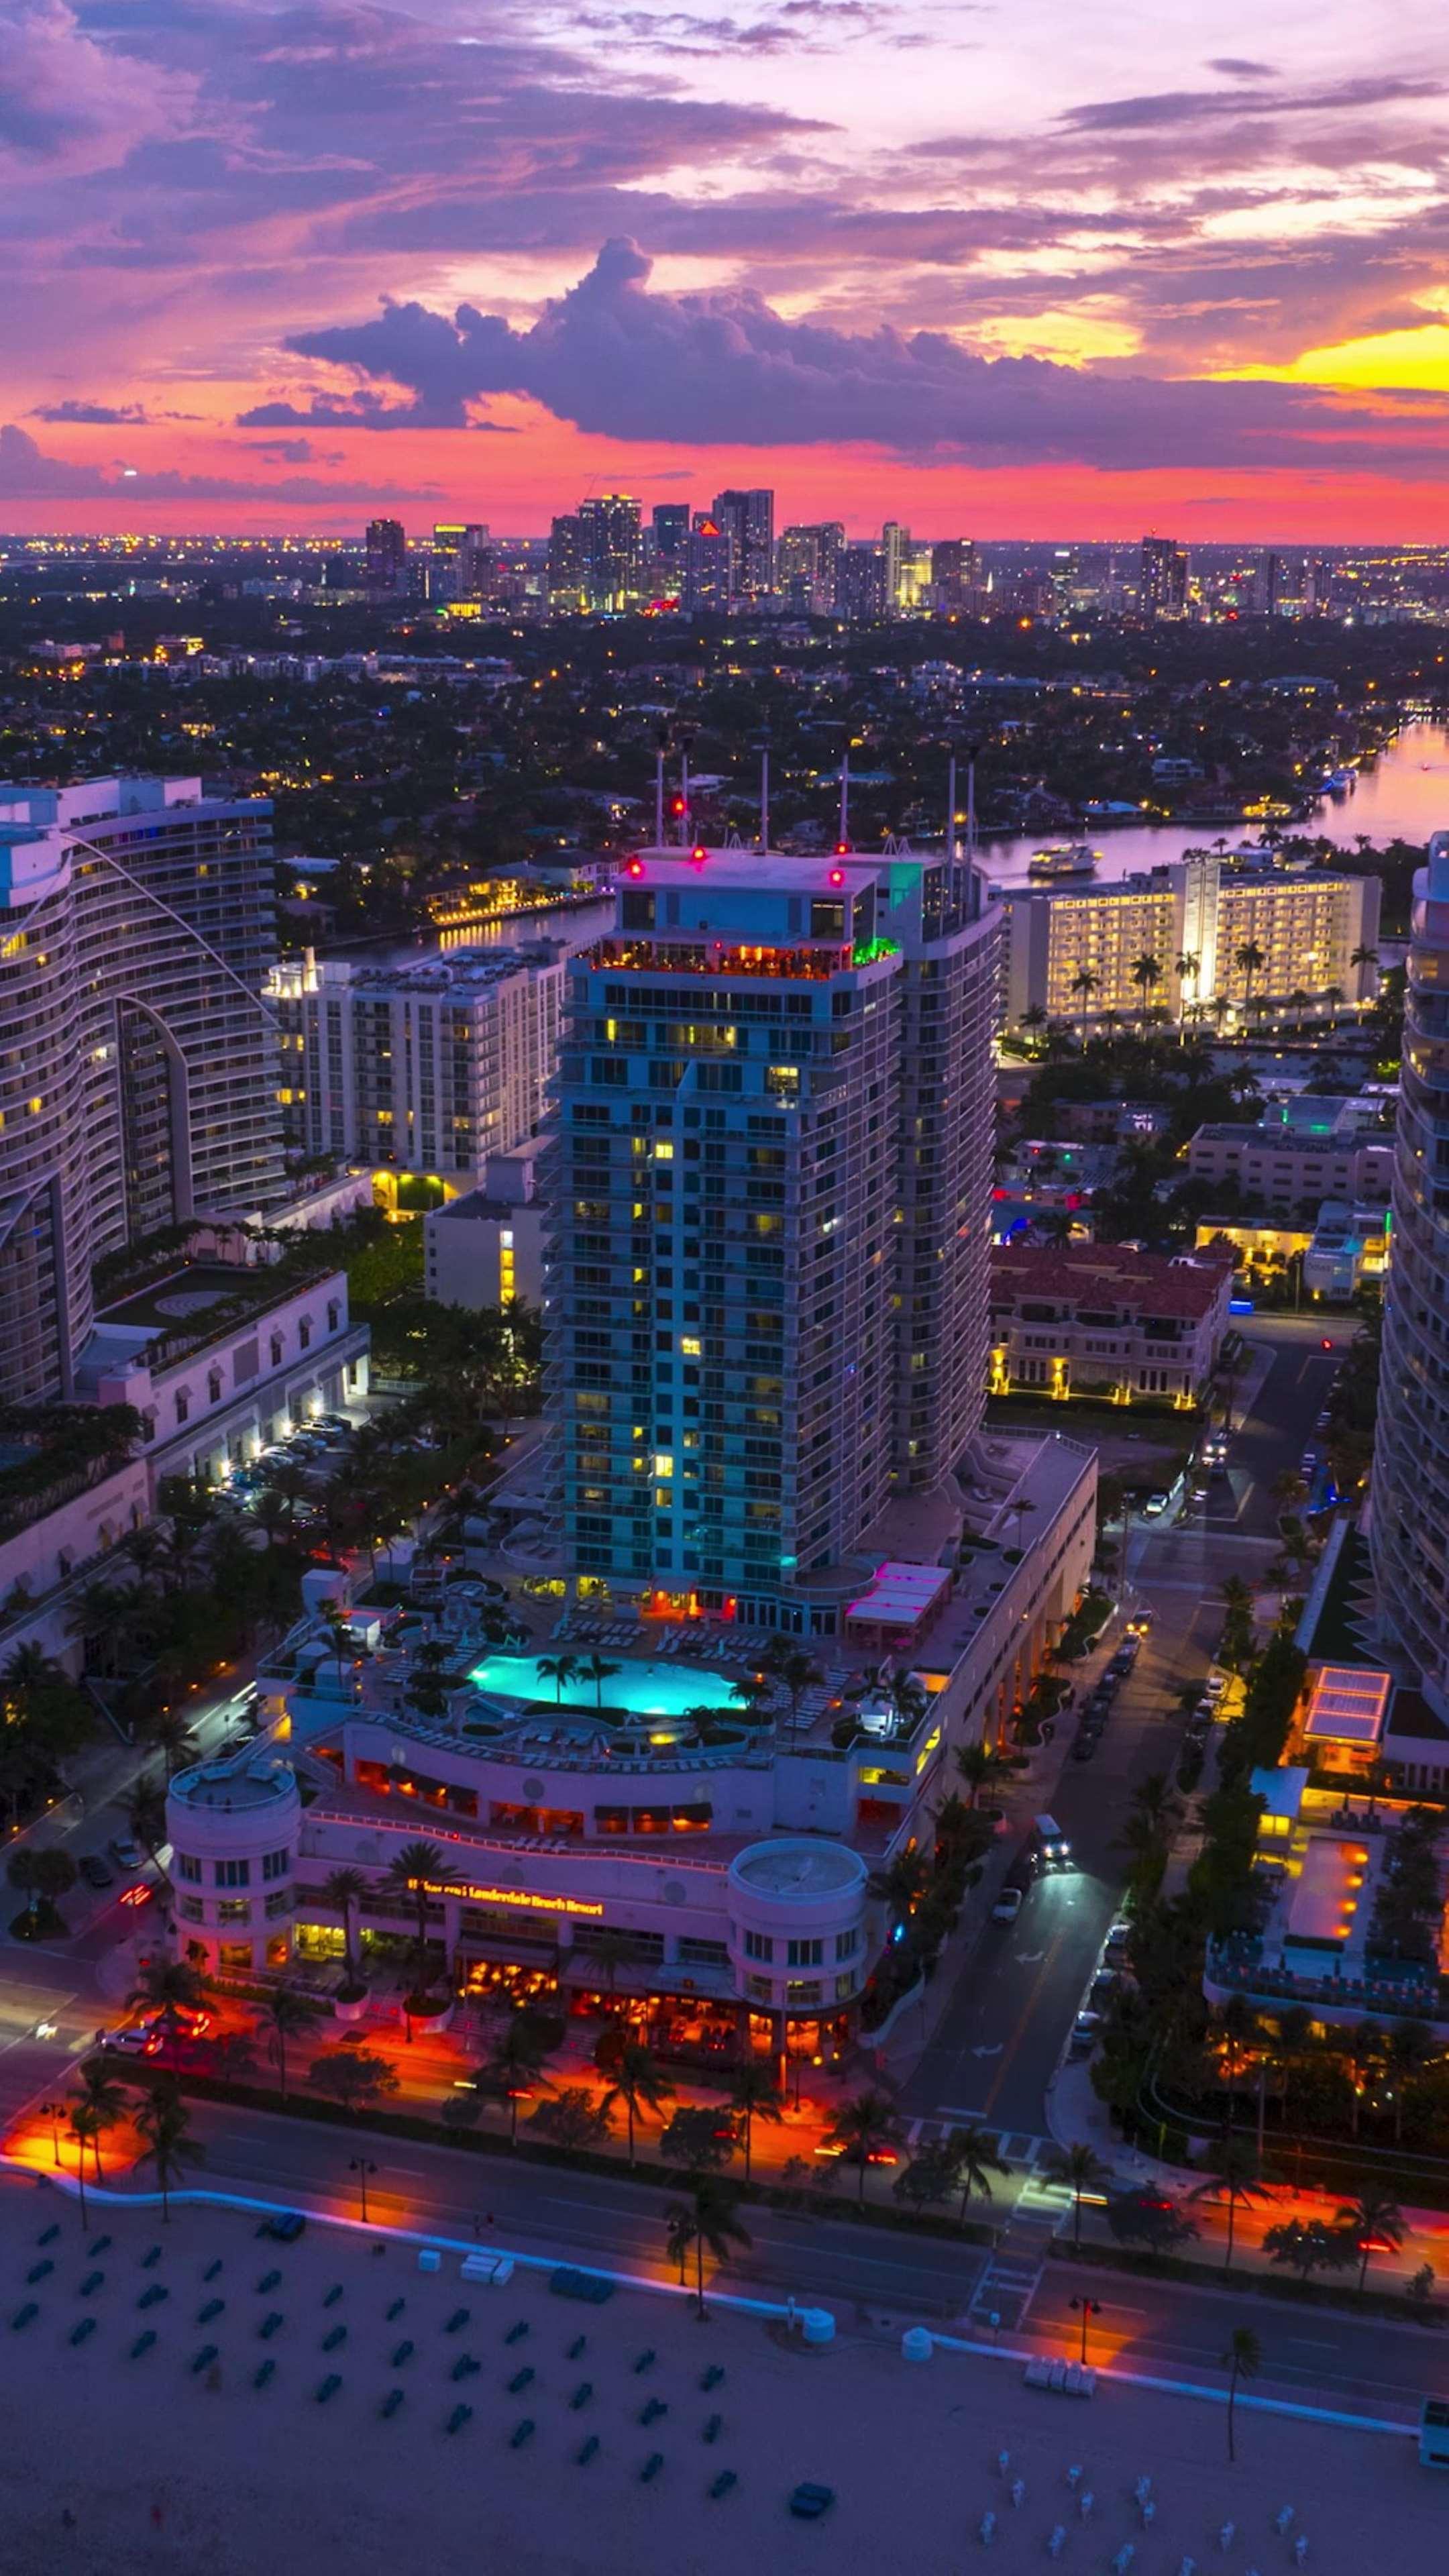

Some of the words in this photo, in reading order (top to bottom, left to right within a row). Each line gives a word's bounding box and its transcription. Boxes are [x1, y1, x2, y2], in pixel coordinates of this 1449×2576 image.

[469, 1886, 531, 1905] Lauderdale
[531, 1895, 566, 1911] Beach
[566, 1900, 603, 1916] Resort
